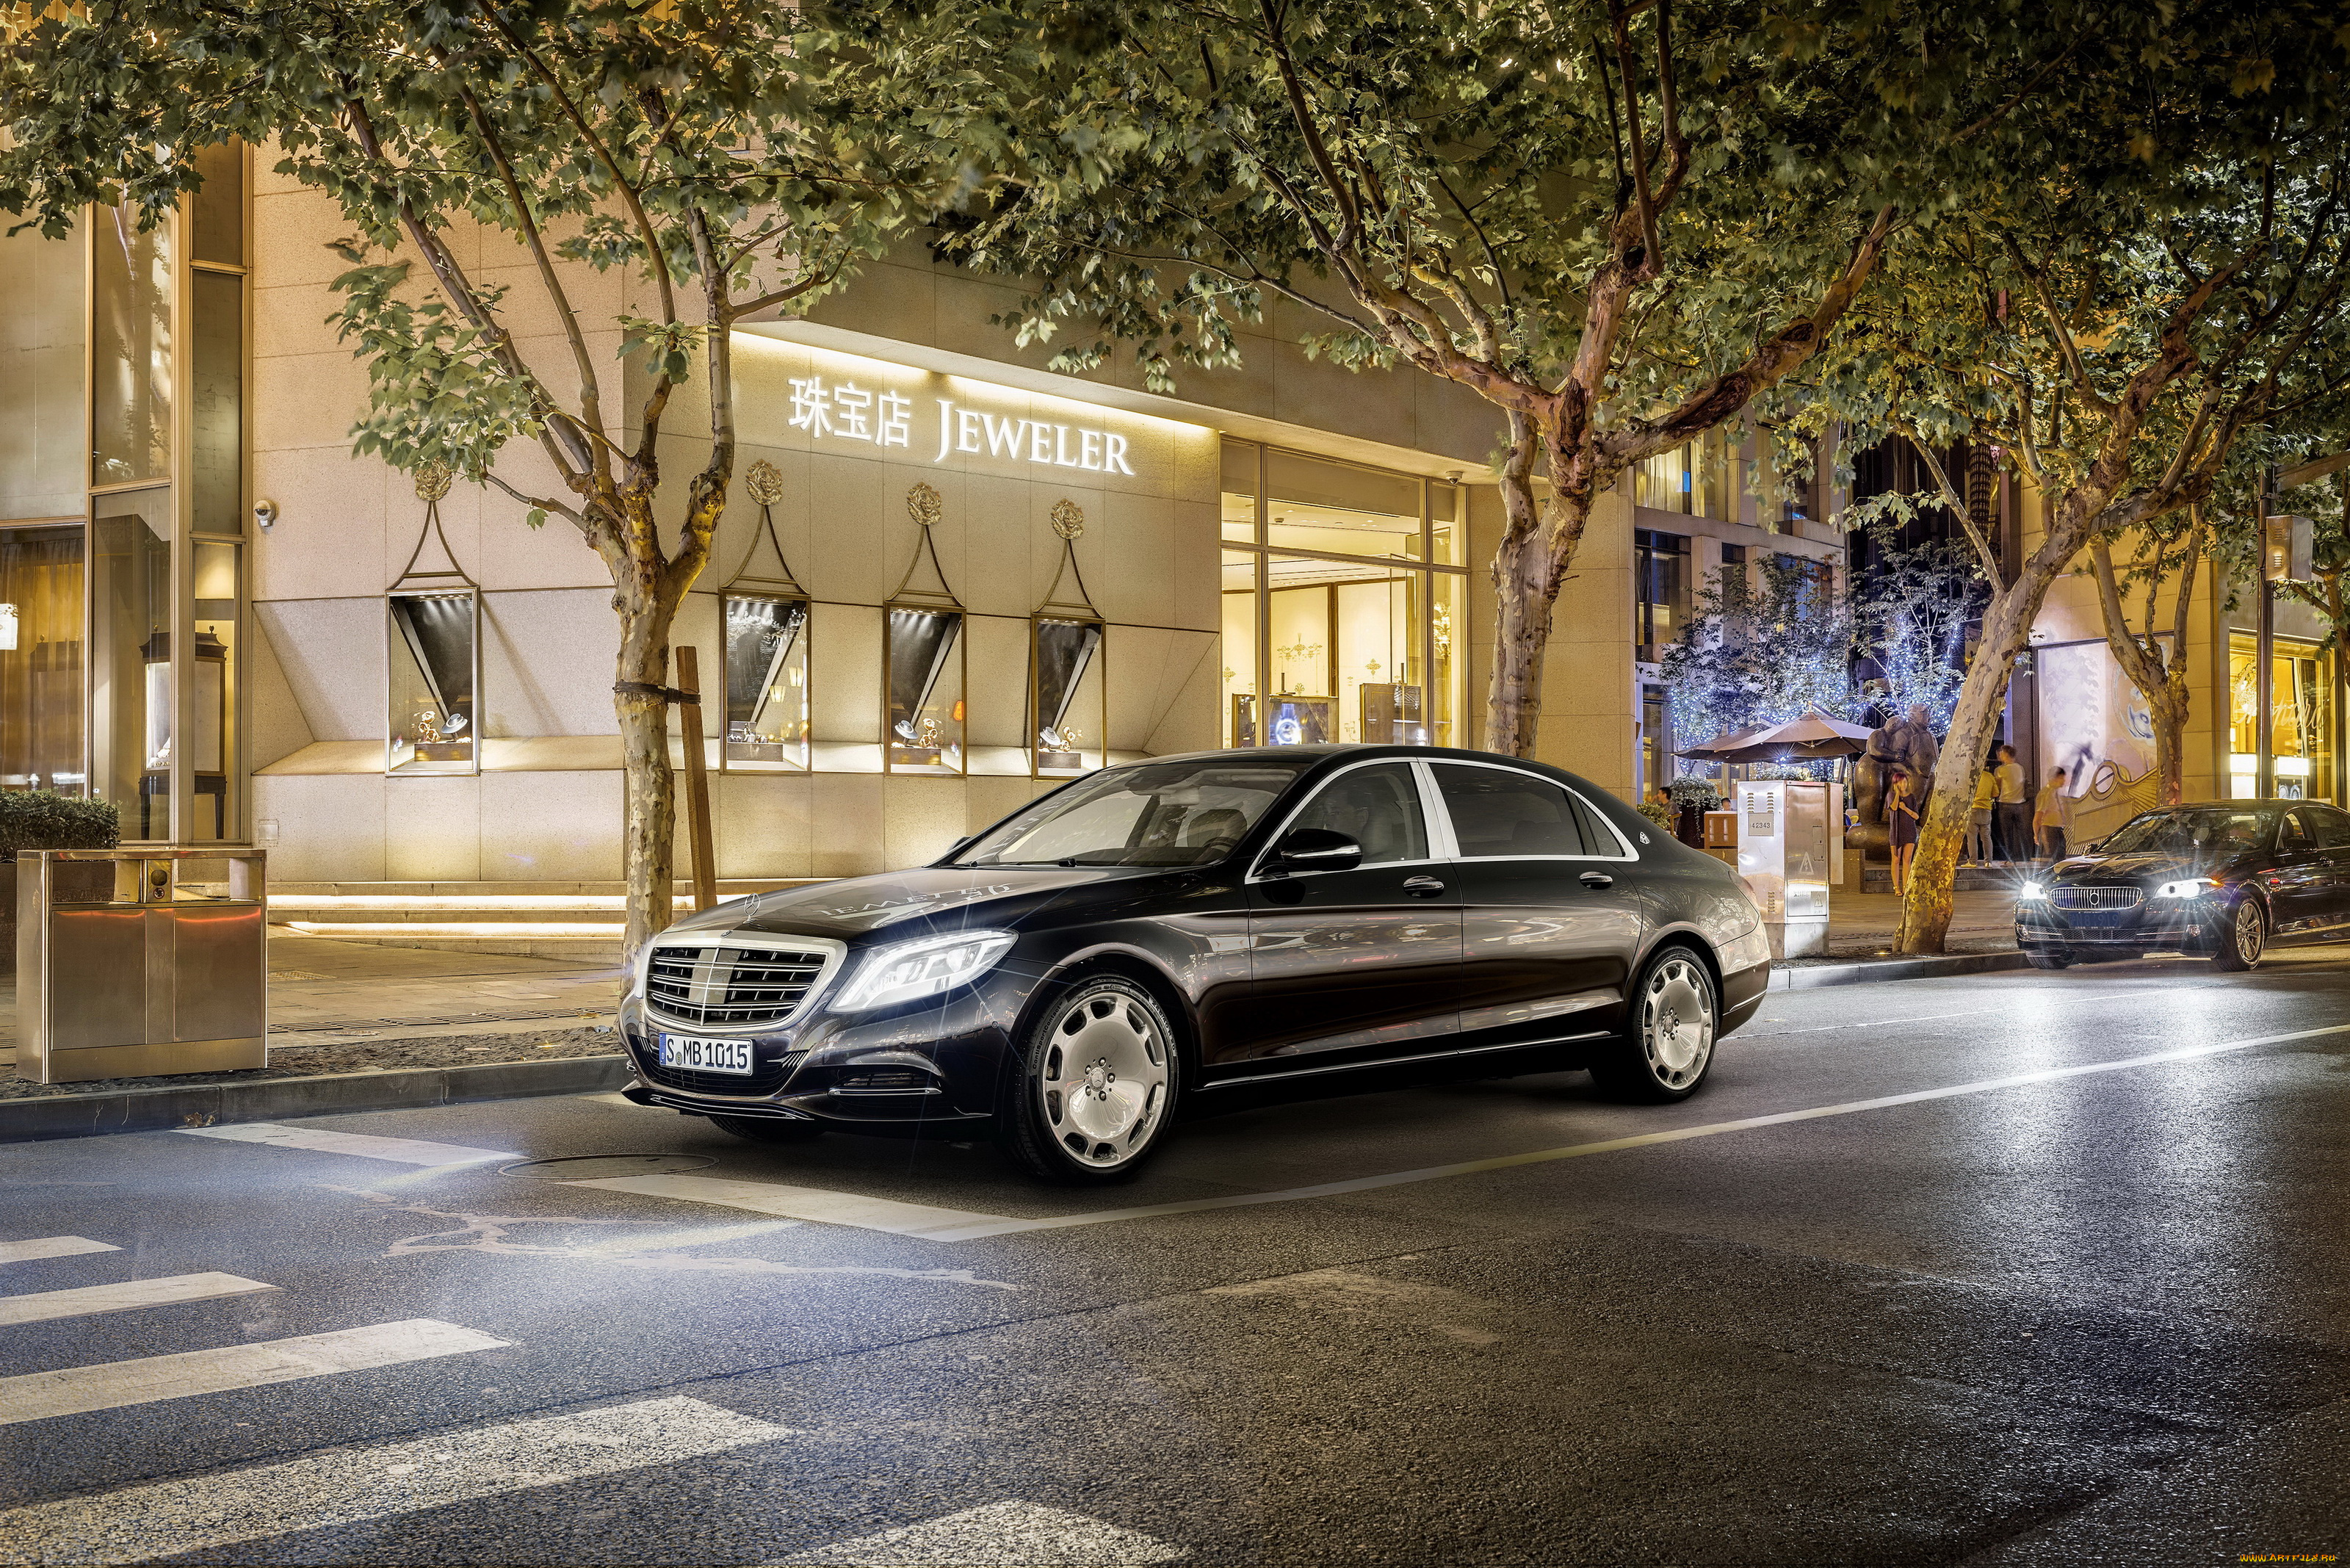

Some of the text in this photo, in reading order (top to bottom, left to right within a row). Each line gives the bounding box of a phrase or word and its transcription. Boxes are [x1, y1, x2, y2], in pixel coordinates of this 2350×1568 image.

[787, 377, 1135, 476] 珠宝店 JEWELER
[667, 1038, 748, 1069] S MB 1015
